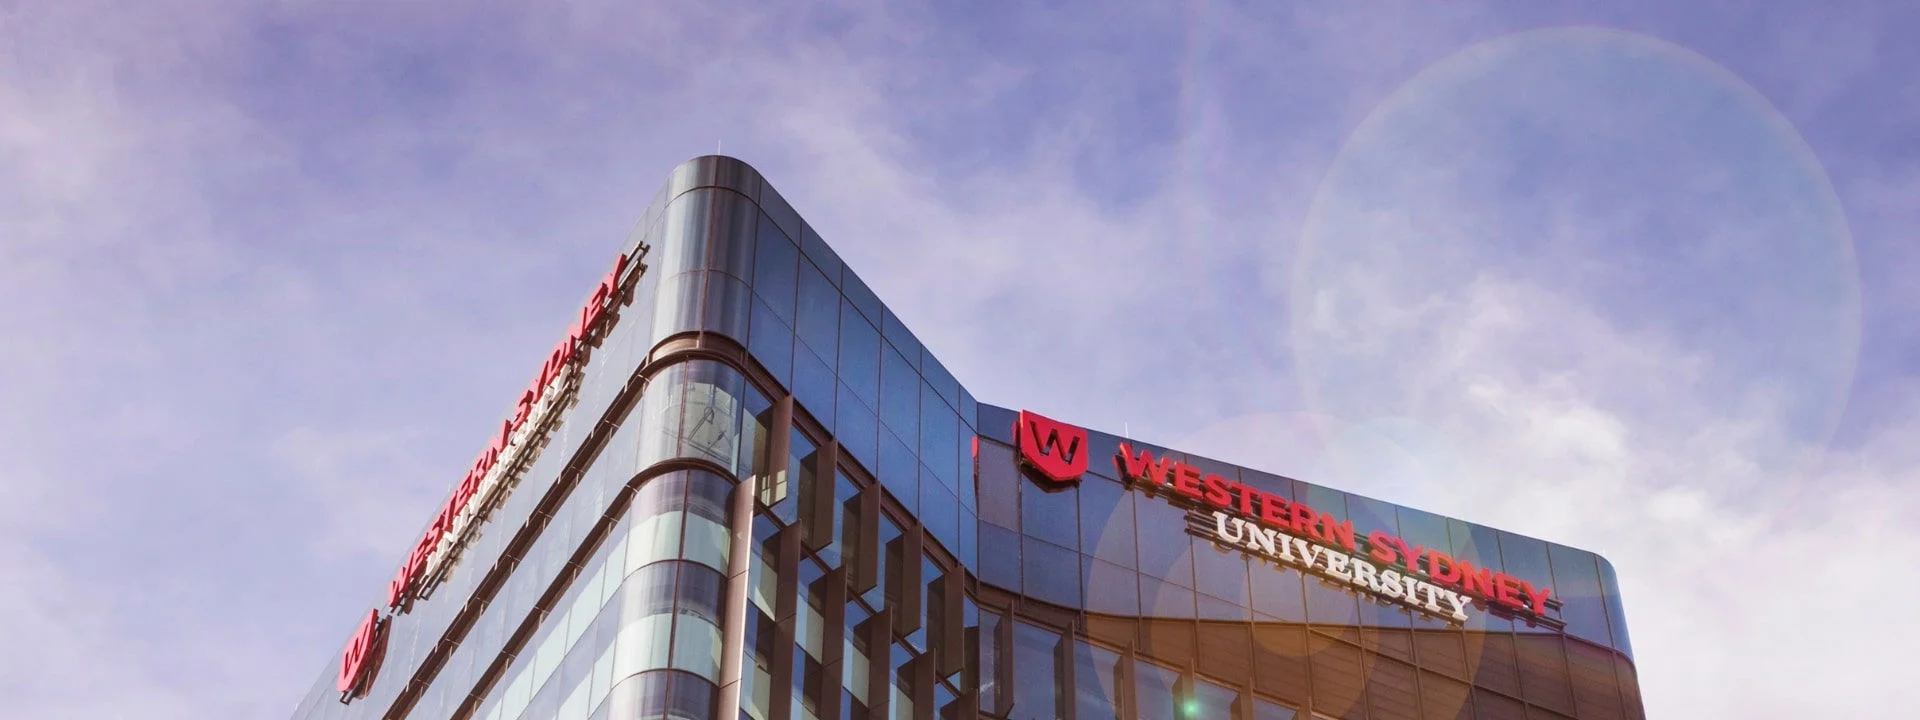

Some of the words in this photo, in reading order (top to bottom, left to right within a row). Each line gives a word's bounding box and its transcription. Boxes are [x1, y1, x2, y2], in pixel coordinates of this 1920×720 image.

[389, 419, 512, 607] WESTERN
[512, 254, 627, 431] SYDNEY
[1030, 421, 1080, 466] W
[1118, 442, 1356, 551] WESTERN
[1368, 530, 1550, 617] SYDNEY
[1212, 511, 1473, 622] UNIVERSITY
